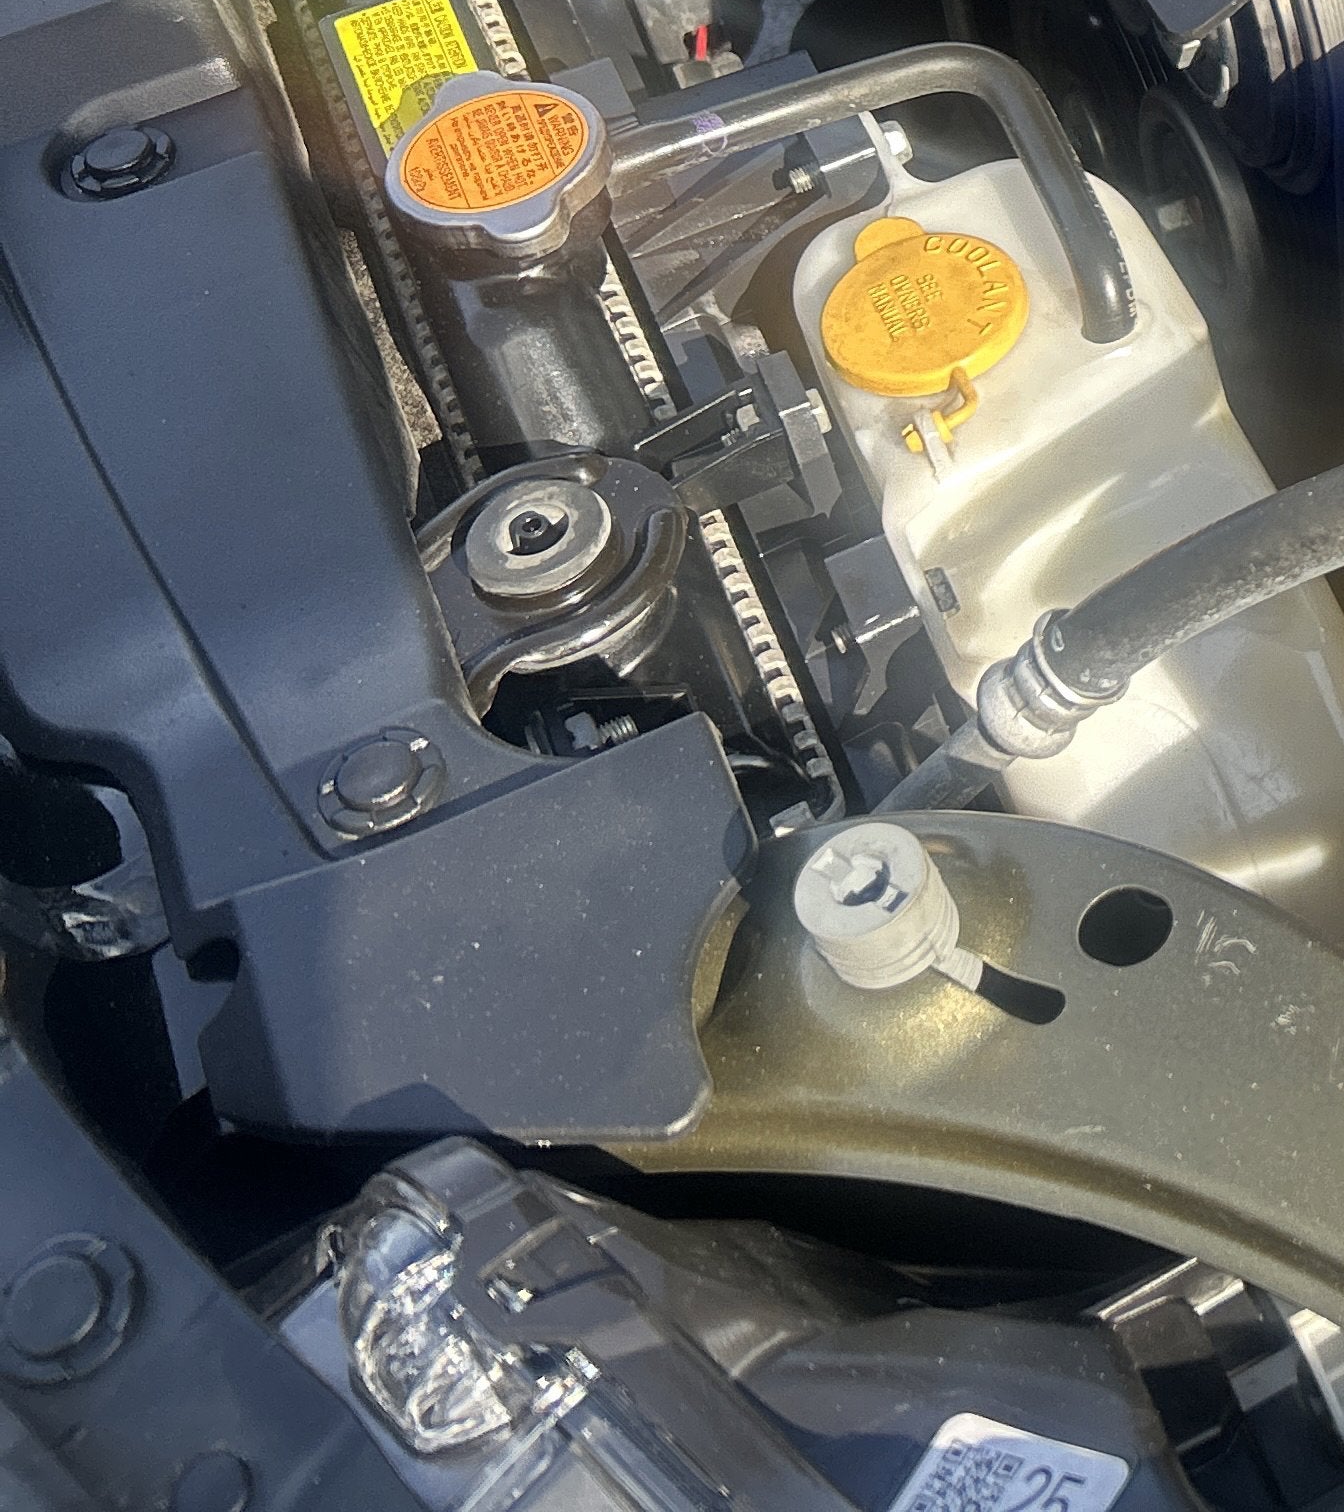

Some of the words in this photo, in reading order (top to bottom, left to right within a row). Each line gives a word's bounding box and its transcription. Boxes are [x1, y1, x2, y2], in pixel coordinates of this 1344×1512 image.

[545, 114, 575, 156] WARNING
[511, 172, 528, 188] HOT
[913, 270, 945, 305] SEE
[924, 235, 1008, 336] COOLANT
[1004, 1465, 1087, 1511] 25
